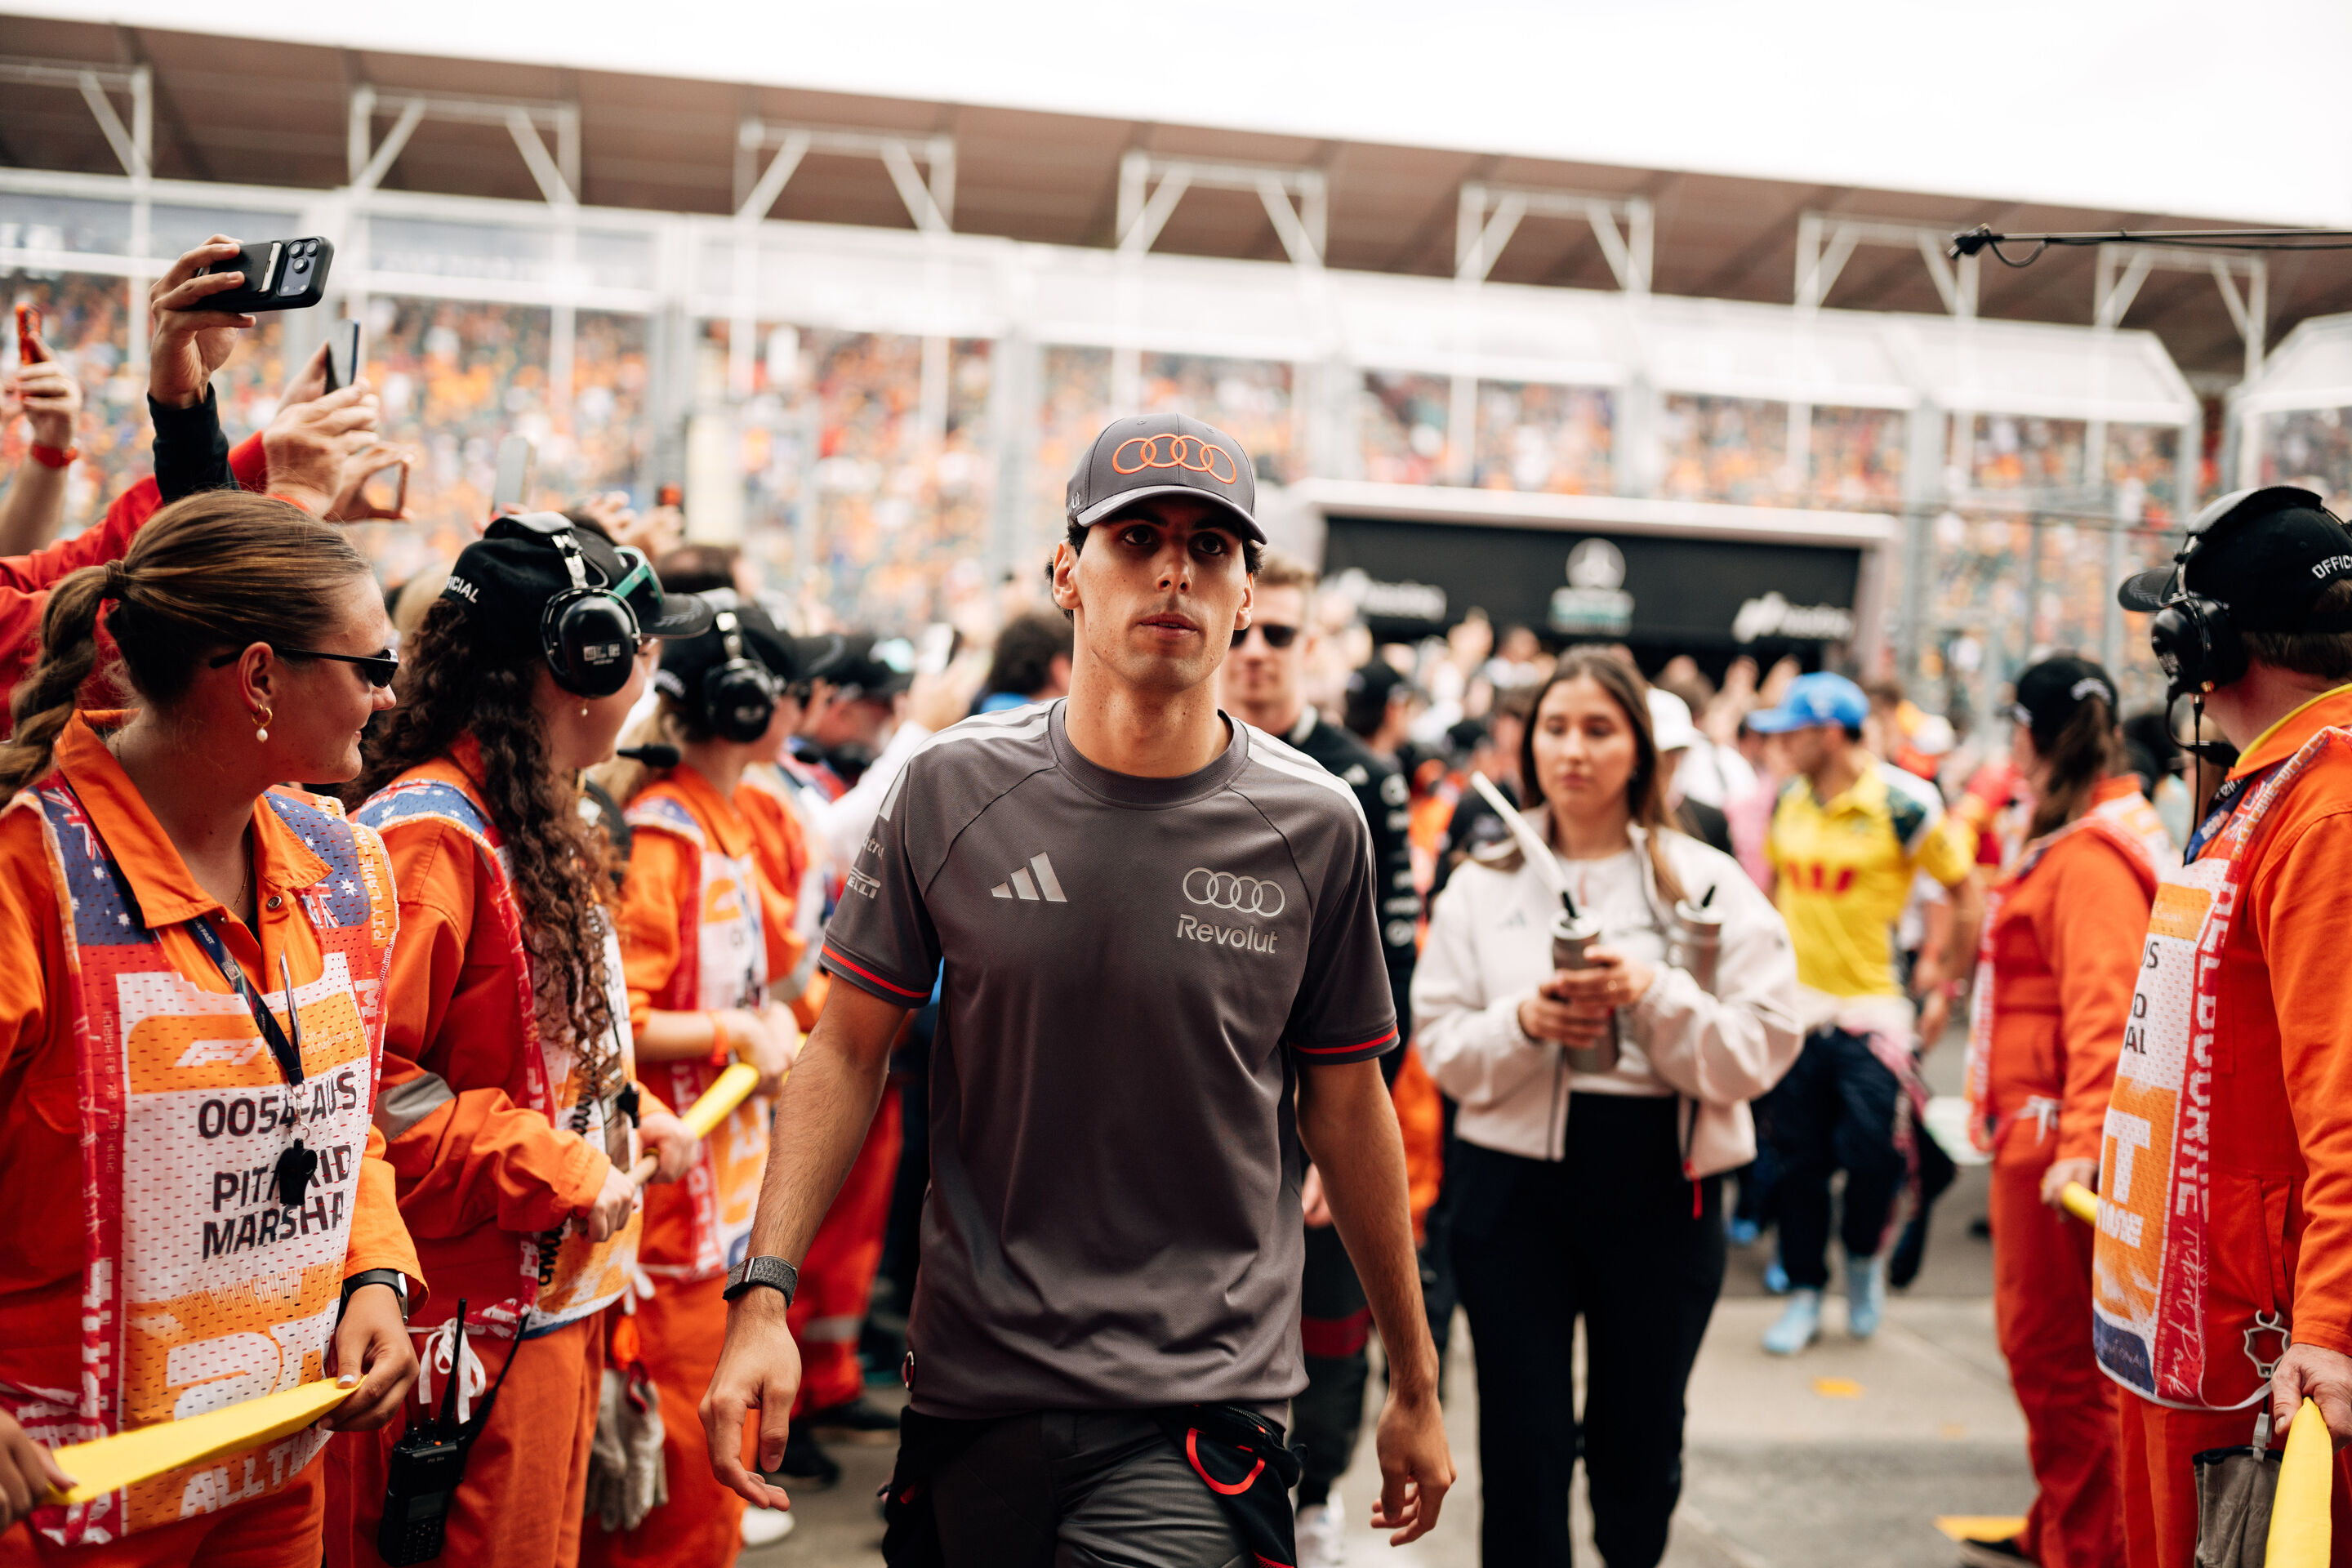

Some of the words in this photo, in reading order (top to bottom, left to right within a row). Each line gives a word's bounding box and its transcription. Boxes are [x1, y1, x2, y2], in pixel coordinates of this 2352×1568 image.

[2311, 555, 2352, 579] OFFIC
[372, 907, 386, 941] PIT
[1176, 913, 1278, 955] Revolut
[102, 1010, 114, 1054] MARCH
[202, 1191, 345, 1260] MARSHA
